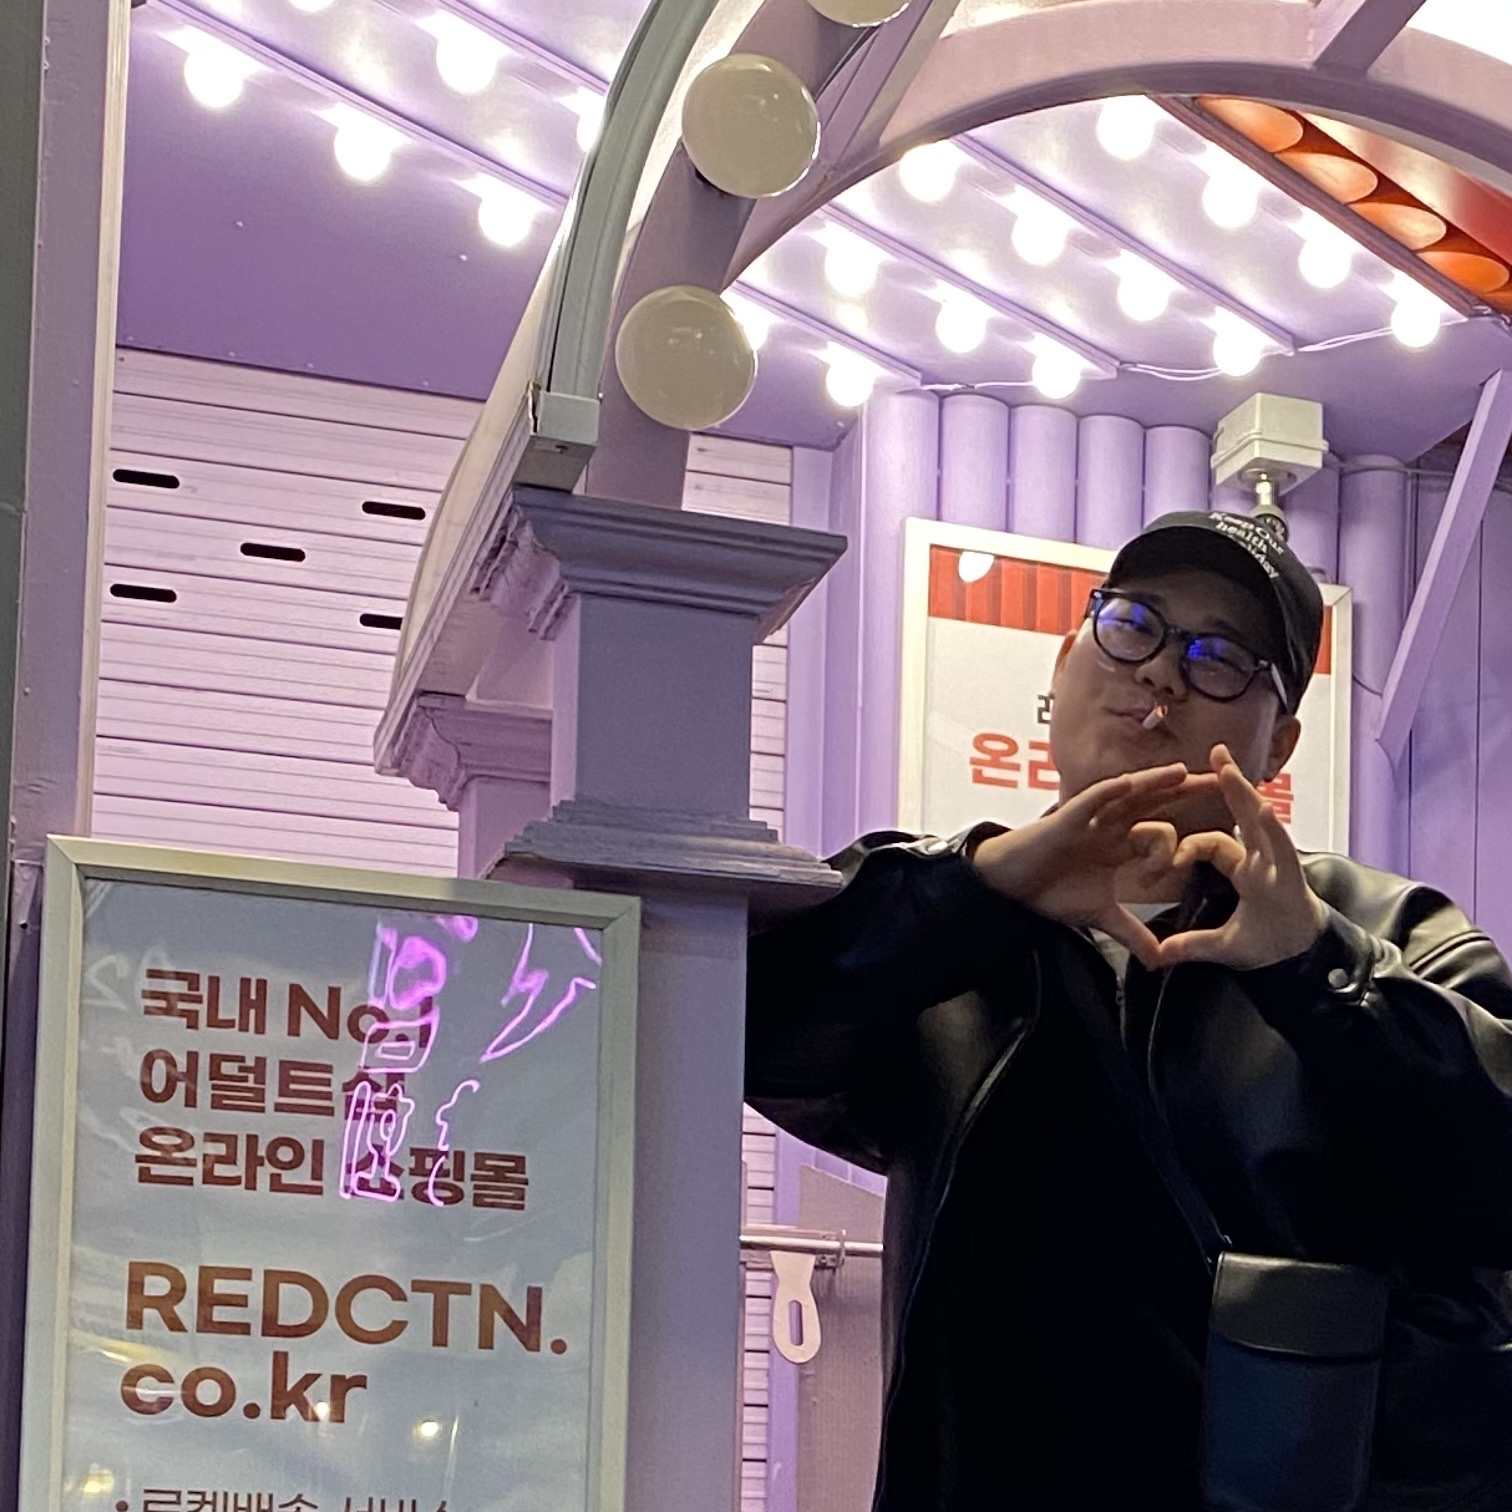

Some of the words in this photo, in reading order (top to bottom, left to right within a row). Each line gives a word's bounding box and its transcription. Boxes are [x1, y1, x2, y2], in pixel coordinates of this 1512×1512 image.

[1216, 521, 1268, 554] health
[141, 968, 267, 1036] 국내
[286, 983, 434, 1049] No.1
[135, 1126, 325, 1195] 온라인
[346, 1144, 529, 1211] 쇼핑몰
[126, 1261, 568, 1355] REDCTN.
[120, 1350, 368, 1423] co.kr
